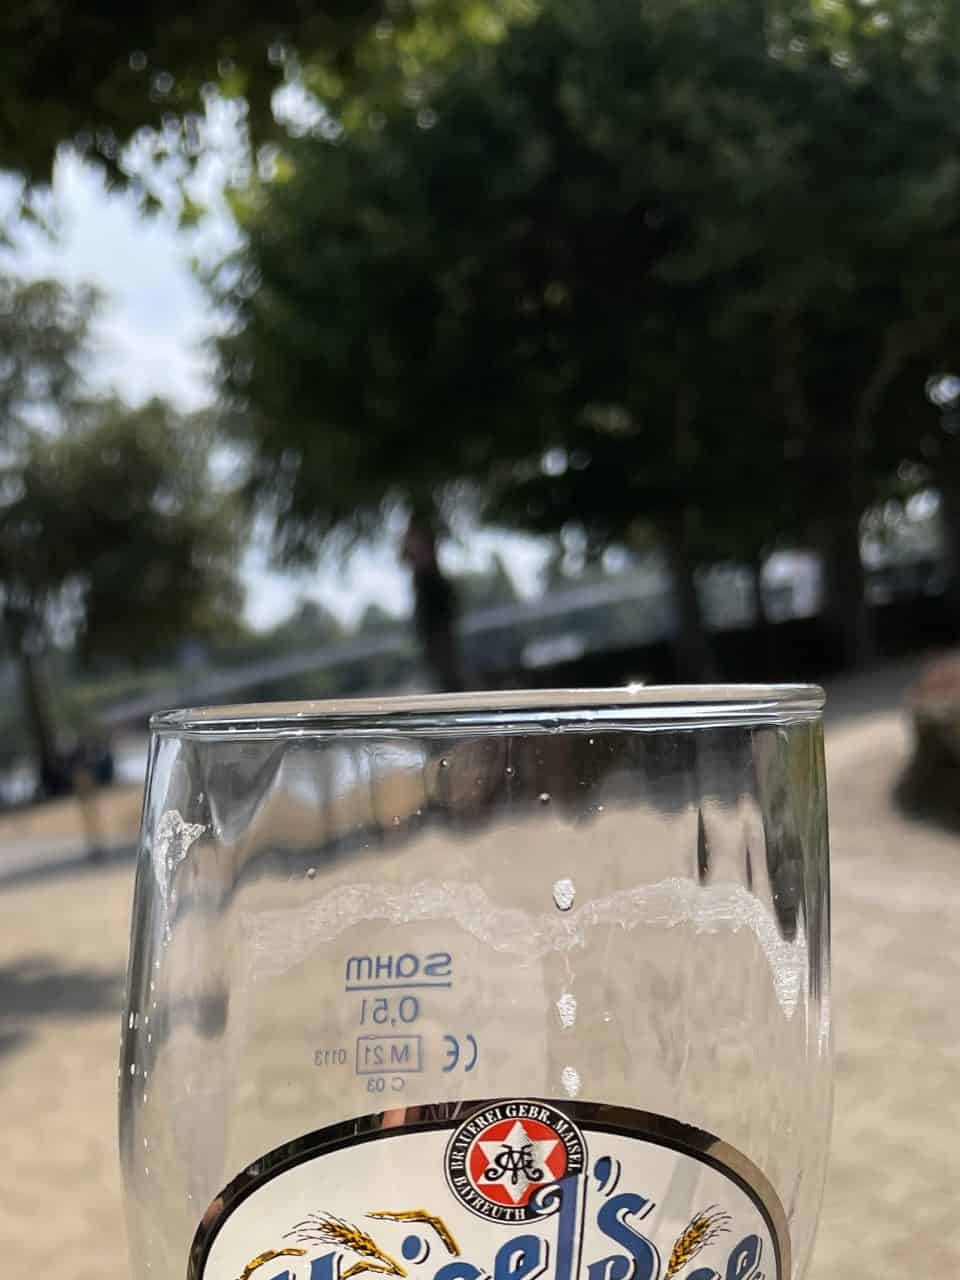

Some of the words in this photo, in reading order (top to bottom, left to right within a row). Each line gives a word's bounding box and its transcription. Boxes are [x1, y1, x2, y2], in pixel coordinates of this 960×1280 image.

[451, 1109, 503, 1170] BRAUEREI
[505, 1105, 551, 1125] GEBR.
[552, 1119, 582, 1172] MAISEL
[453, 1175, 526, 1220] BAYREUTH
